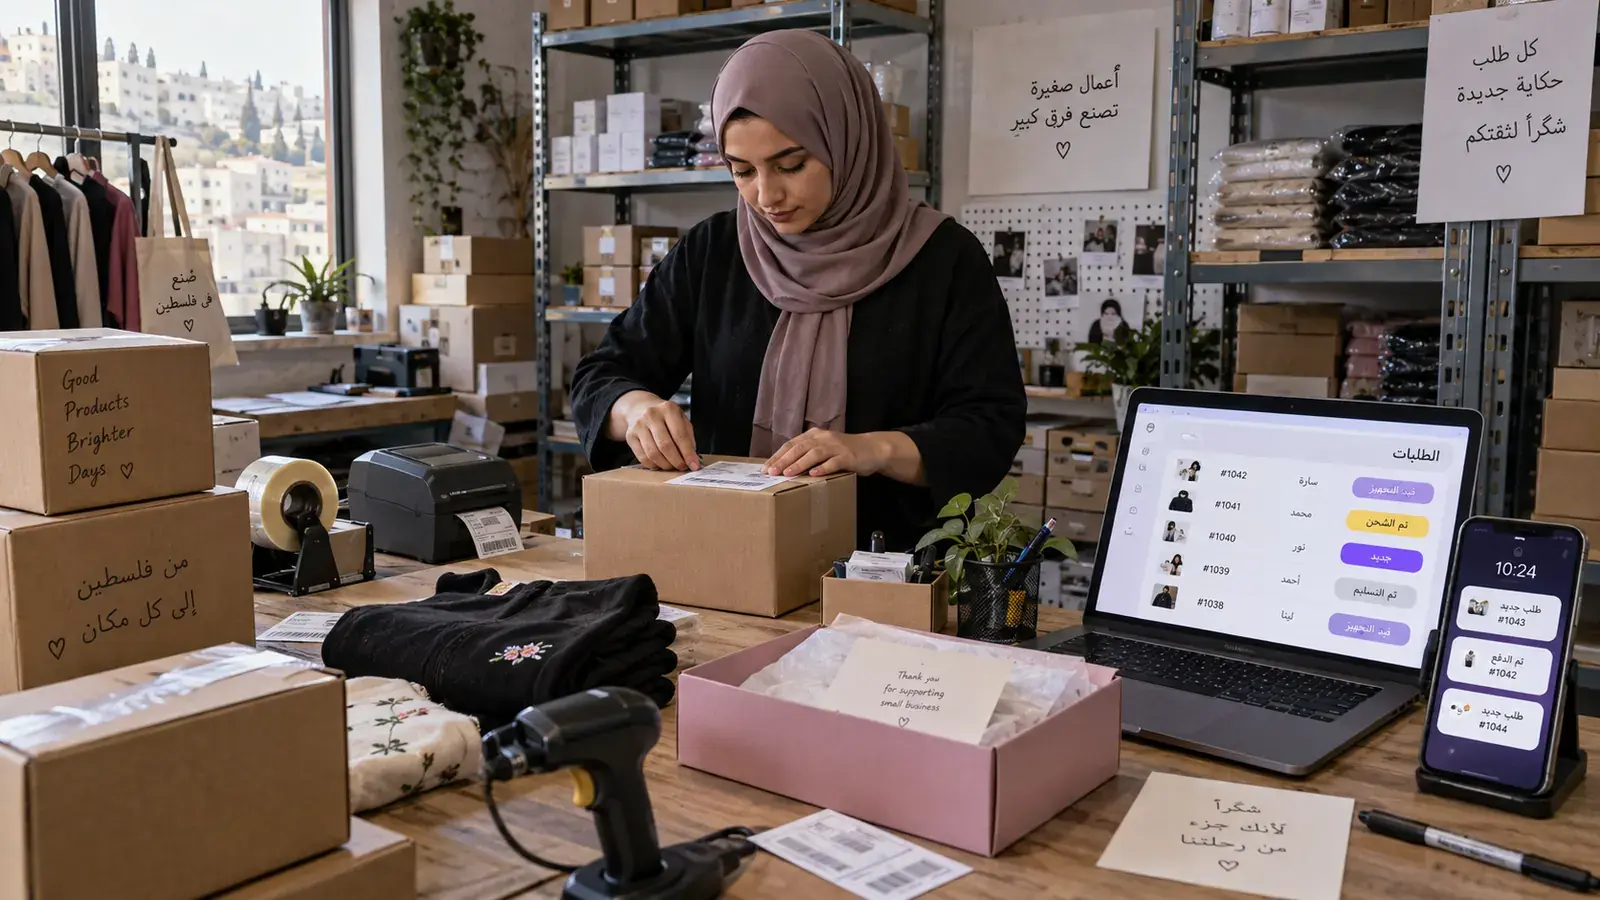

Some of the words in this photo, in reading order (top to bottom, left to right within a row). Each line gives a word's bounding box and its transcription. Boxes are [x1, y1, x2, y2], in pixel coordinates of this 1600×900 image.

[1516, 37, 1539, 63] كل
[1472, 44, 1510, 71] طلب
[1079, 63, 1121, 94] أعمال
[1516, 70, 1564, 97] حكاية
[1030, 79, 1073, 100] صغيرة
[1457, 86, 1508, 104] جديدة
[1079, 103, 1119, 128] تصنع
[1465, 121, 1518, 153] لثقتكم
[155, 294, 197, 315] فلسطين
[62, 364, 99, 394] Good
[64, 393, 130, 422] Products
[67, 425, 135, 455] Brighter
[1392, 447, 1440, 463] الطلبات
[68, 463, 106, 488] Days
[1220, 469, 1248, 480] #1042
[1298, 476, 1319, 487] سارة
[1214, 500, 1241, 511] #1041
[1290, 508, 1313, 518] محمد
[1365, 518, 1395, 528] الشحن
[1208, 532, 1236, 543] #1040
[1370, 553, 1392, 564] جديد
[163, 557, 189, 579] من
[1203, 564, 1230, 576] #1039
[1495, 561, 1537, 579] 10:24
[77, 559, 153, 601] فلسطين
[1280, 574, 1301, 586] أحمد
[1353, 586, 1385, 597] التسليم
[1386, 590, 1398, 601] تم
[171, 589, 198, 620] إلى
[1196, 598, 1225, 610] #1038
[1499, 603, 1520, 613] جديد
[1522, 604, 1542, 614] طلب
[139, 597, 162, 628] كل
[1280, 610, 1295, 622] لينا
[82, 608, 129, 644] مكان
[1497, 616, 1526, 627] #1043
[1491, 653, 1513, 665] الدفع
[1514, 657, 1524, 667] تم
[898, 670, 922, 681] Thank
[924, 676, 940, 684] you
[1488, 668, 1517, 680] #1042
[883, 683, 898, 694] for
[899, 687, 945, 700] supporting
[880, 700, 904, 708] small
[904, 700, 941, 712] business
[1481, 707, 1502, 719] جديد
[1504, 711, 1524, 721] طلب
[1478, 721, 1508, 734] #1044
[1189, 820, 1229, 831] جزء
[1181, 833, 1246, 852] رحلتنا
[1257, 844, 1287, 855] من
